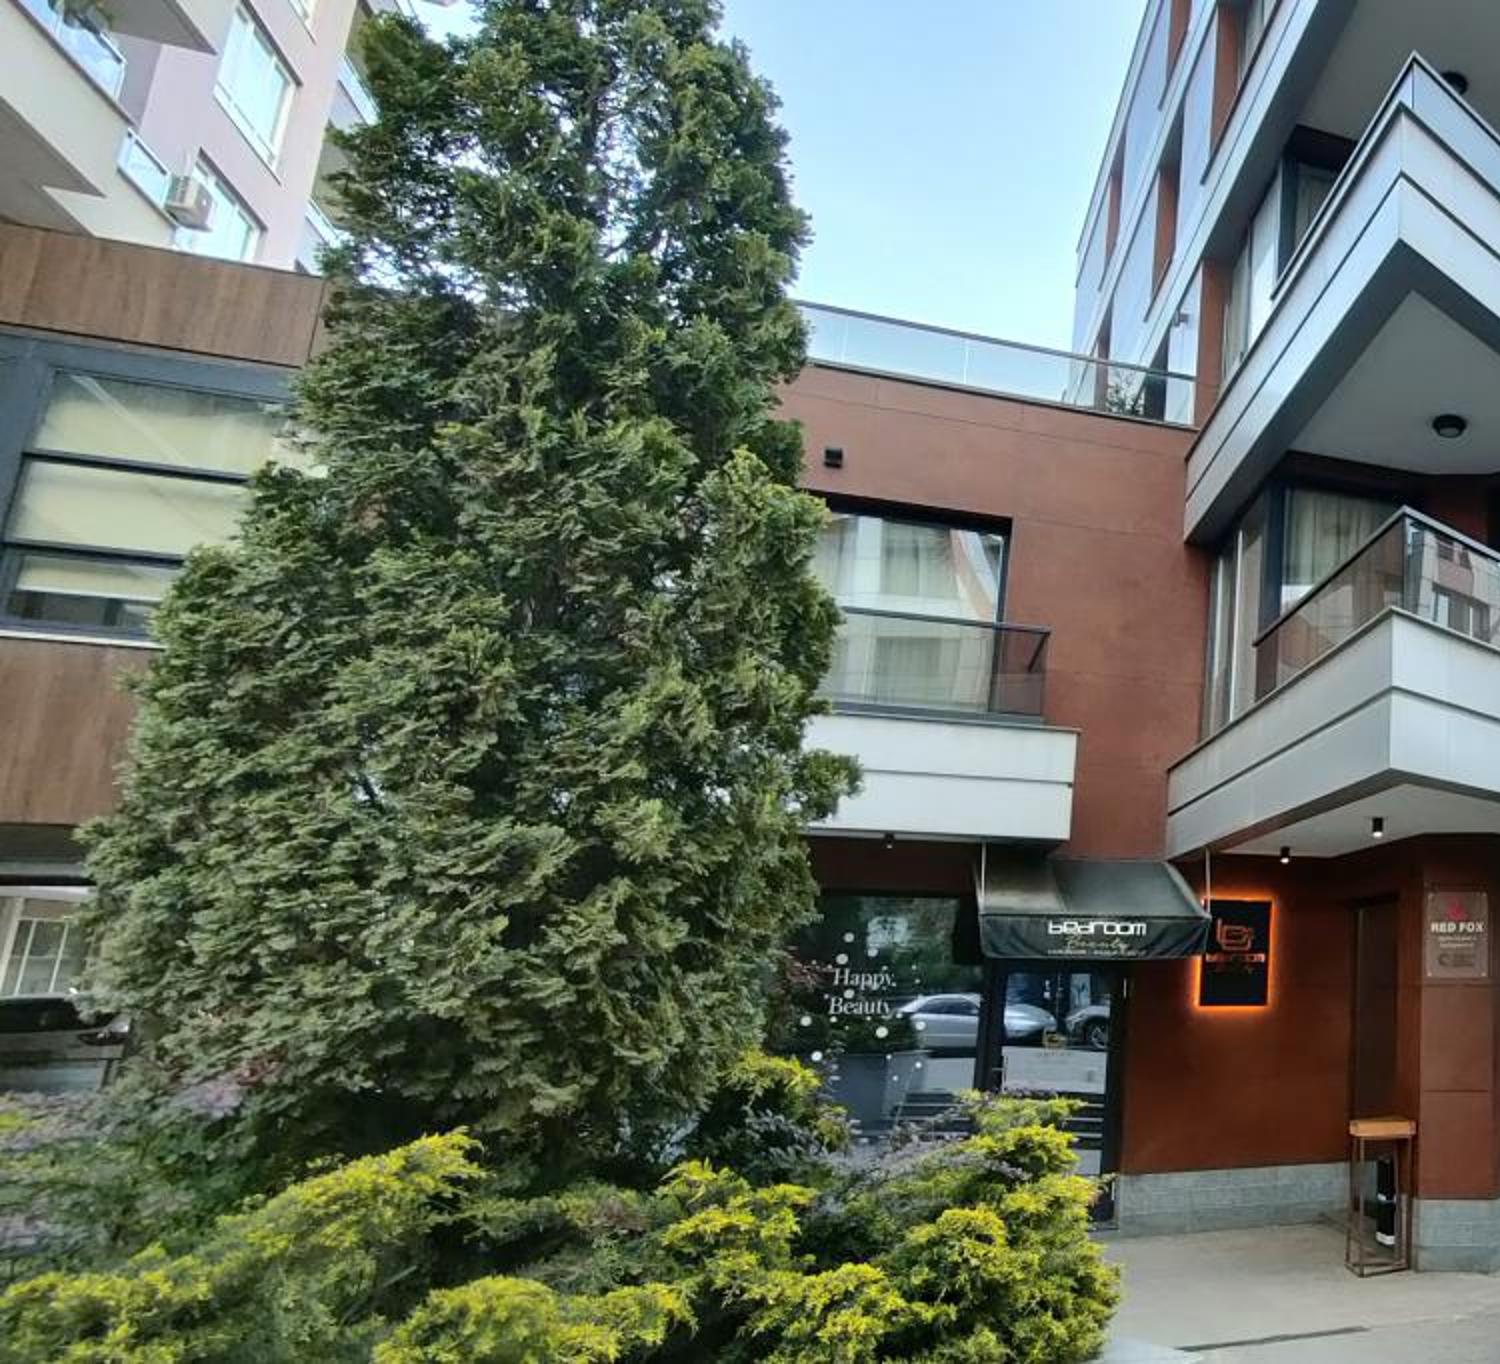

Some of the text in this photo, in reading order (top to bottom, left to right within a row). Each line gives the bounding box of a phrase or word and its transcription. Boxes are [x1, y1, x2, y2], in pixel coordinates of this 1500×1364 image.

[1048, 920, 1147, 937] bedroom
[1430, 921, 1484, 933] RED FOX
[833, 967, 895, 990] Happy
[829, 997, 893, 1019] Beauty
